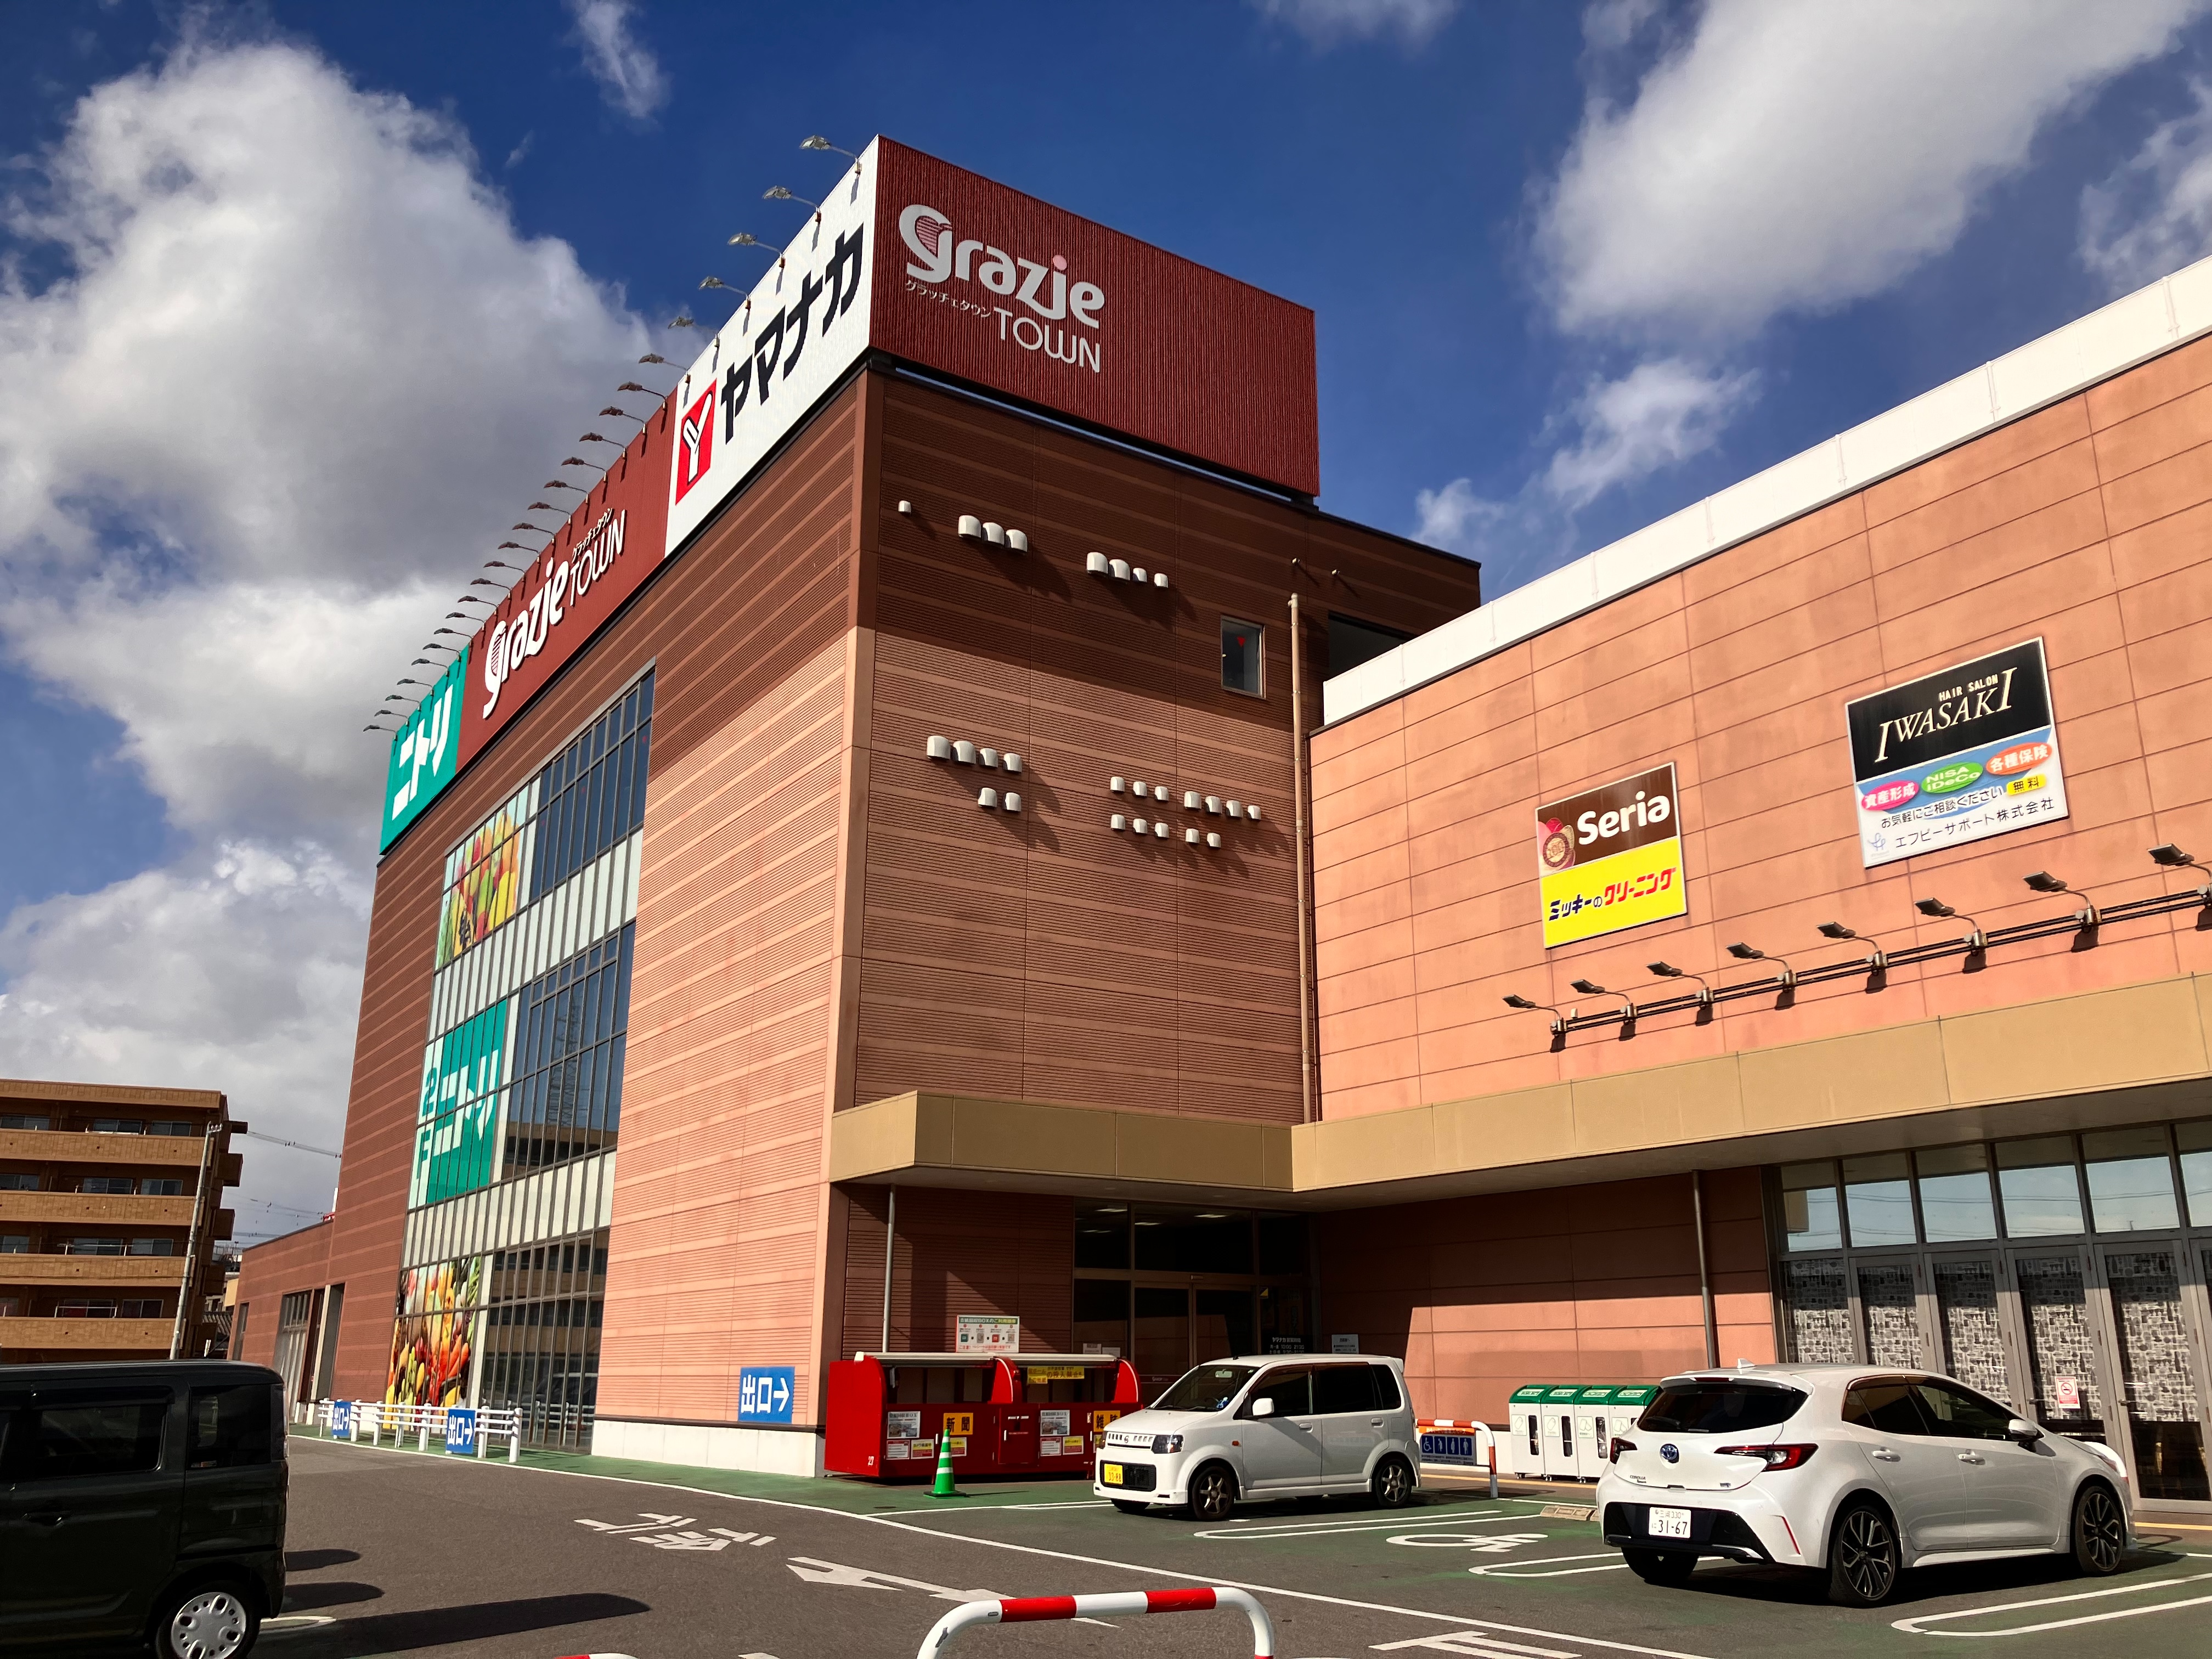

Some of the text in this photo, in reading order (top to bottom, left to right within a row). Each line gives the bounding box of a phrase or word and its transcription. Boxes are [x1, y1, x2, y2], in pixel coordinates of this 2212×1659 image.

[720, 222, 865, 445] ヤマナカ
[994, 307, 1101, 374] TOWN
[570, 509, 625, 607] TOWN
[1938, 674, 1998, 702] HAIR SALON
[1875, 667, 2018, 763] IWASAKI
[391, 684, 453, 821] ニトリ
[1990, 744, 2049, 772] 各種保険
[1865, 782, 1916, 809] 資産形成
[1926, 766, 1970, 783] NISA
[2013, 776, 2039, 792] 無料
[1577, 791, 1671, 845] Seria
[1881, 786, 2002, 828] お気軽にご相談ください
[1895, 797, 2055, 848] エフピーサポート株式会社
[1548, 866, 1677, 922] ミッキーのクリーニング
[416, 1067, 437, 1180] 2F
[432, 1048, 499, 1157] ニトリ
[741, 1374, 771, 1413] 出口
[332, 1406, 345, 1431] 出口
[447, 1415, 465, 1446] 出口
[946, 1417, 970, 1433] 新聞
[1658, 1519, 1688, 1535] 31-67
